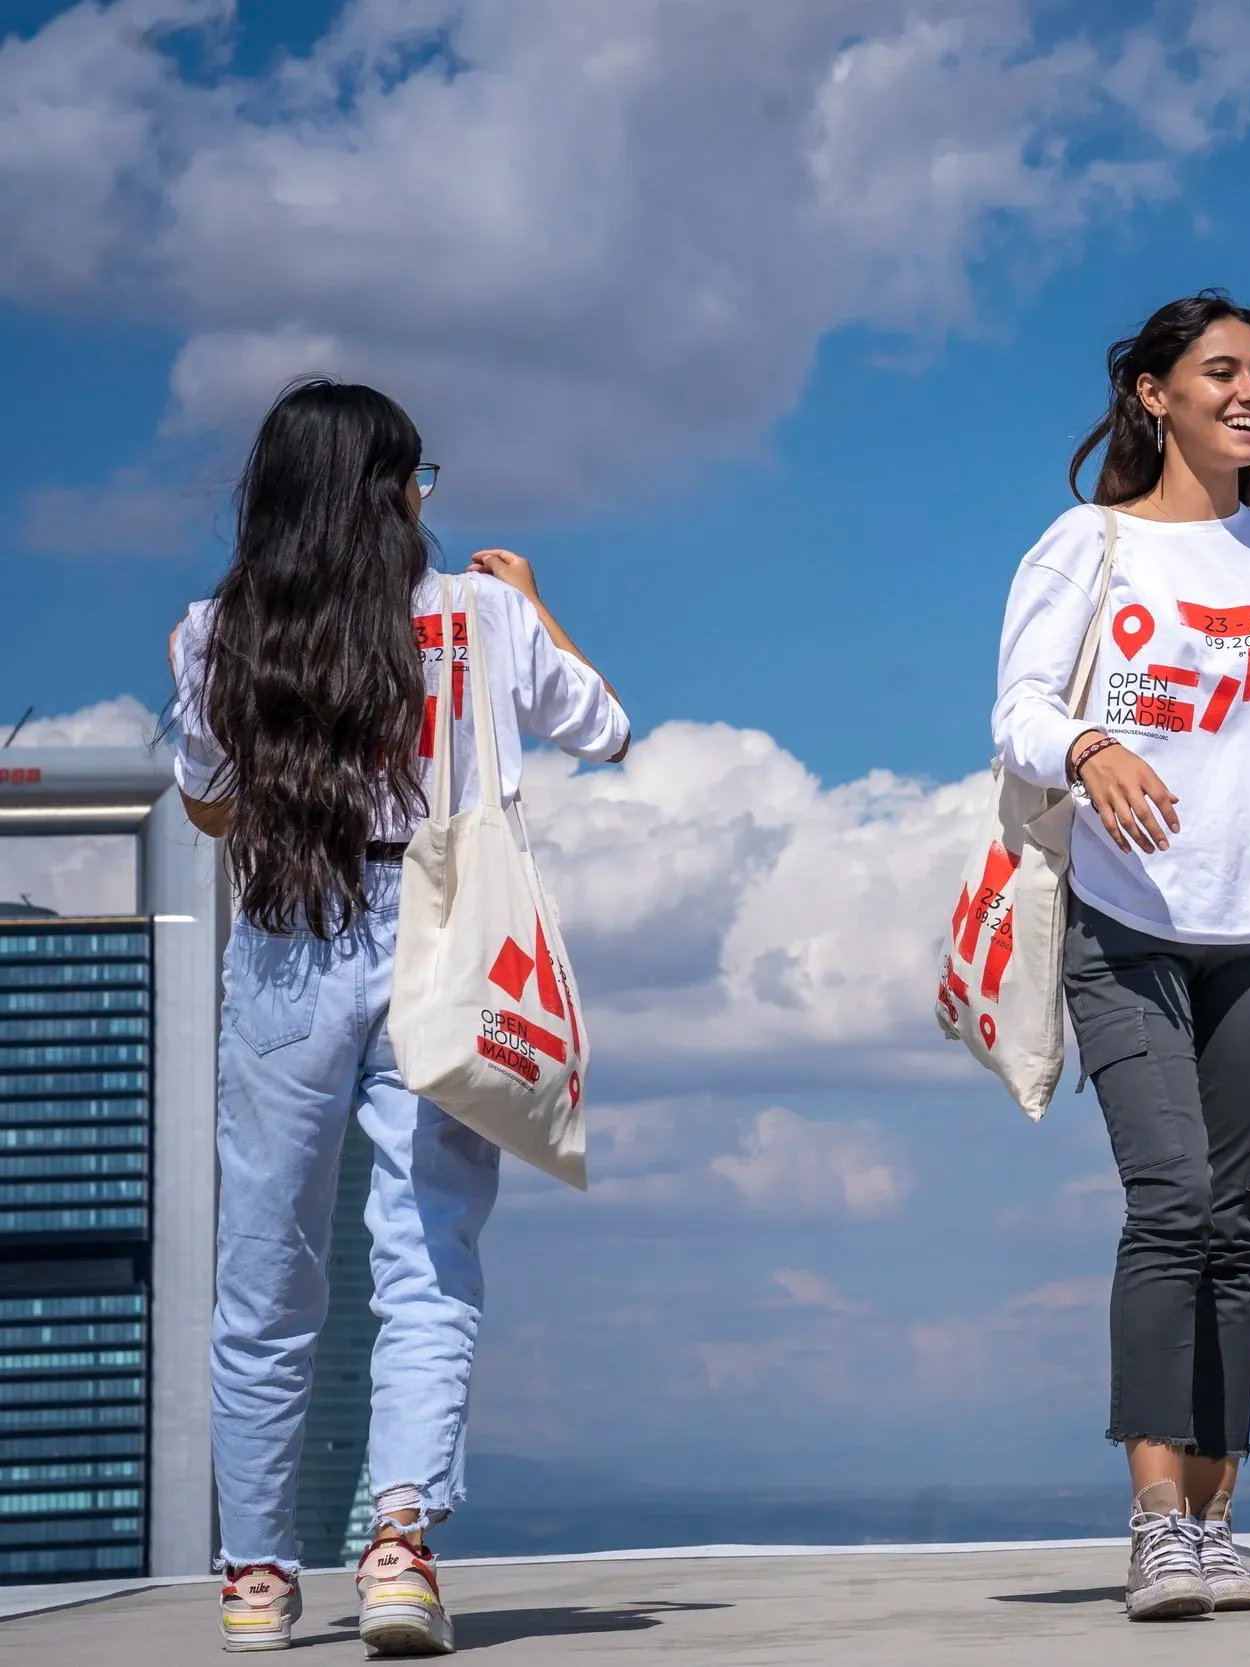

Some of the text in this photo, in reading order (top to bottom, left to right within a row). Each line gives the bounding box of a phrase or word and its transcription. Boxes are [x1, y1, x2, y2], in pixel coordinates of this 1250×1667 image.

[1204, 614, 1229, 633] 23
[1108, 672, 1169, 693] OPEN
[1106, 690, 1177, 714] HOUSE
[1105, 708, 1185, 733] MADRID
[1107, 728, 1169, 742] PENHOUSEMADRID.ORG
[981, 887, 1006, 910] 23
[481, 1009, 528, 1041] OPEN
[482, 1023, 537, 1062] HOUSE
[482, 1040, 541, 1082] MADRID
[377, 1553, 400, 1567] nike
[249, 1581, 271, 1594] nike
